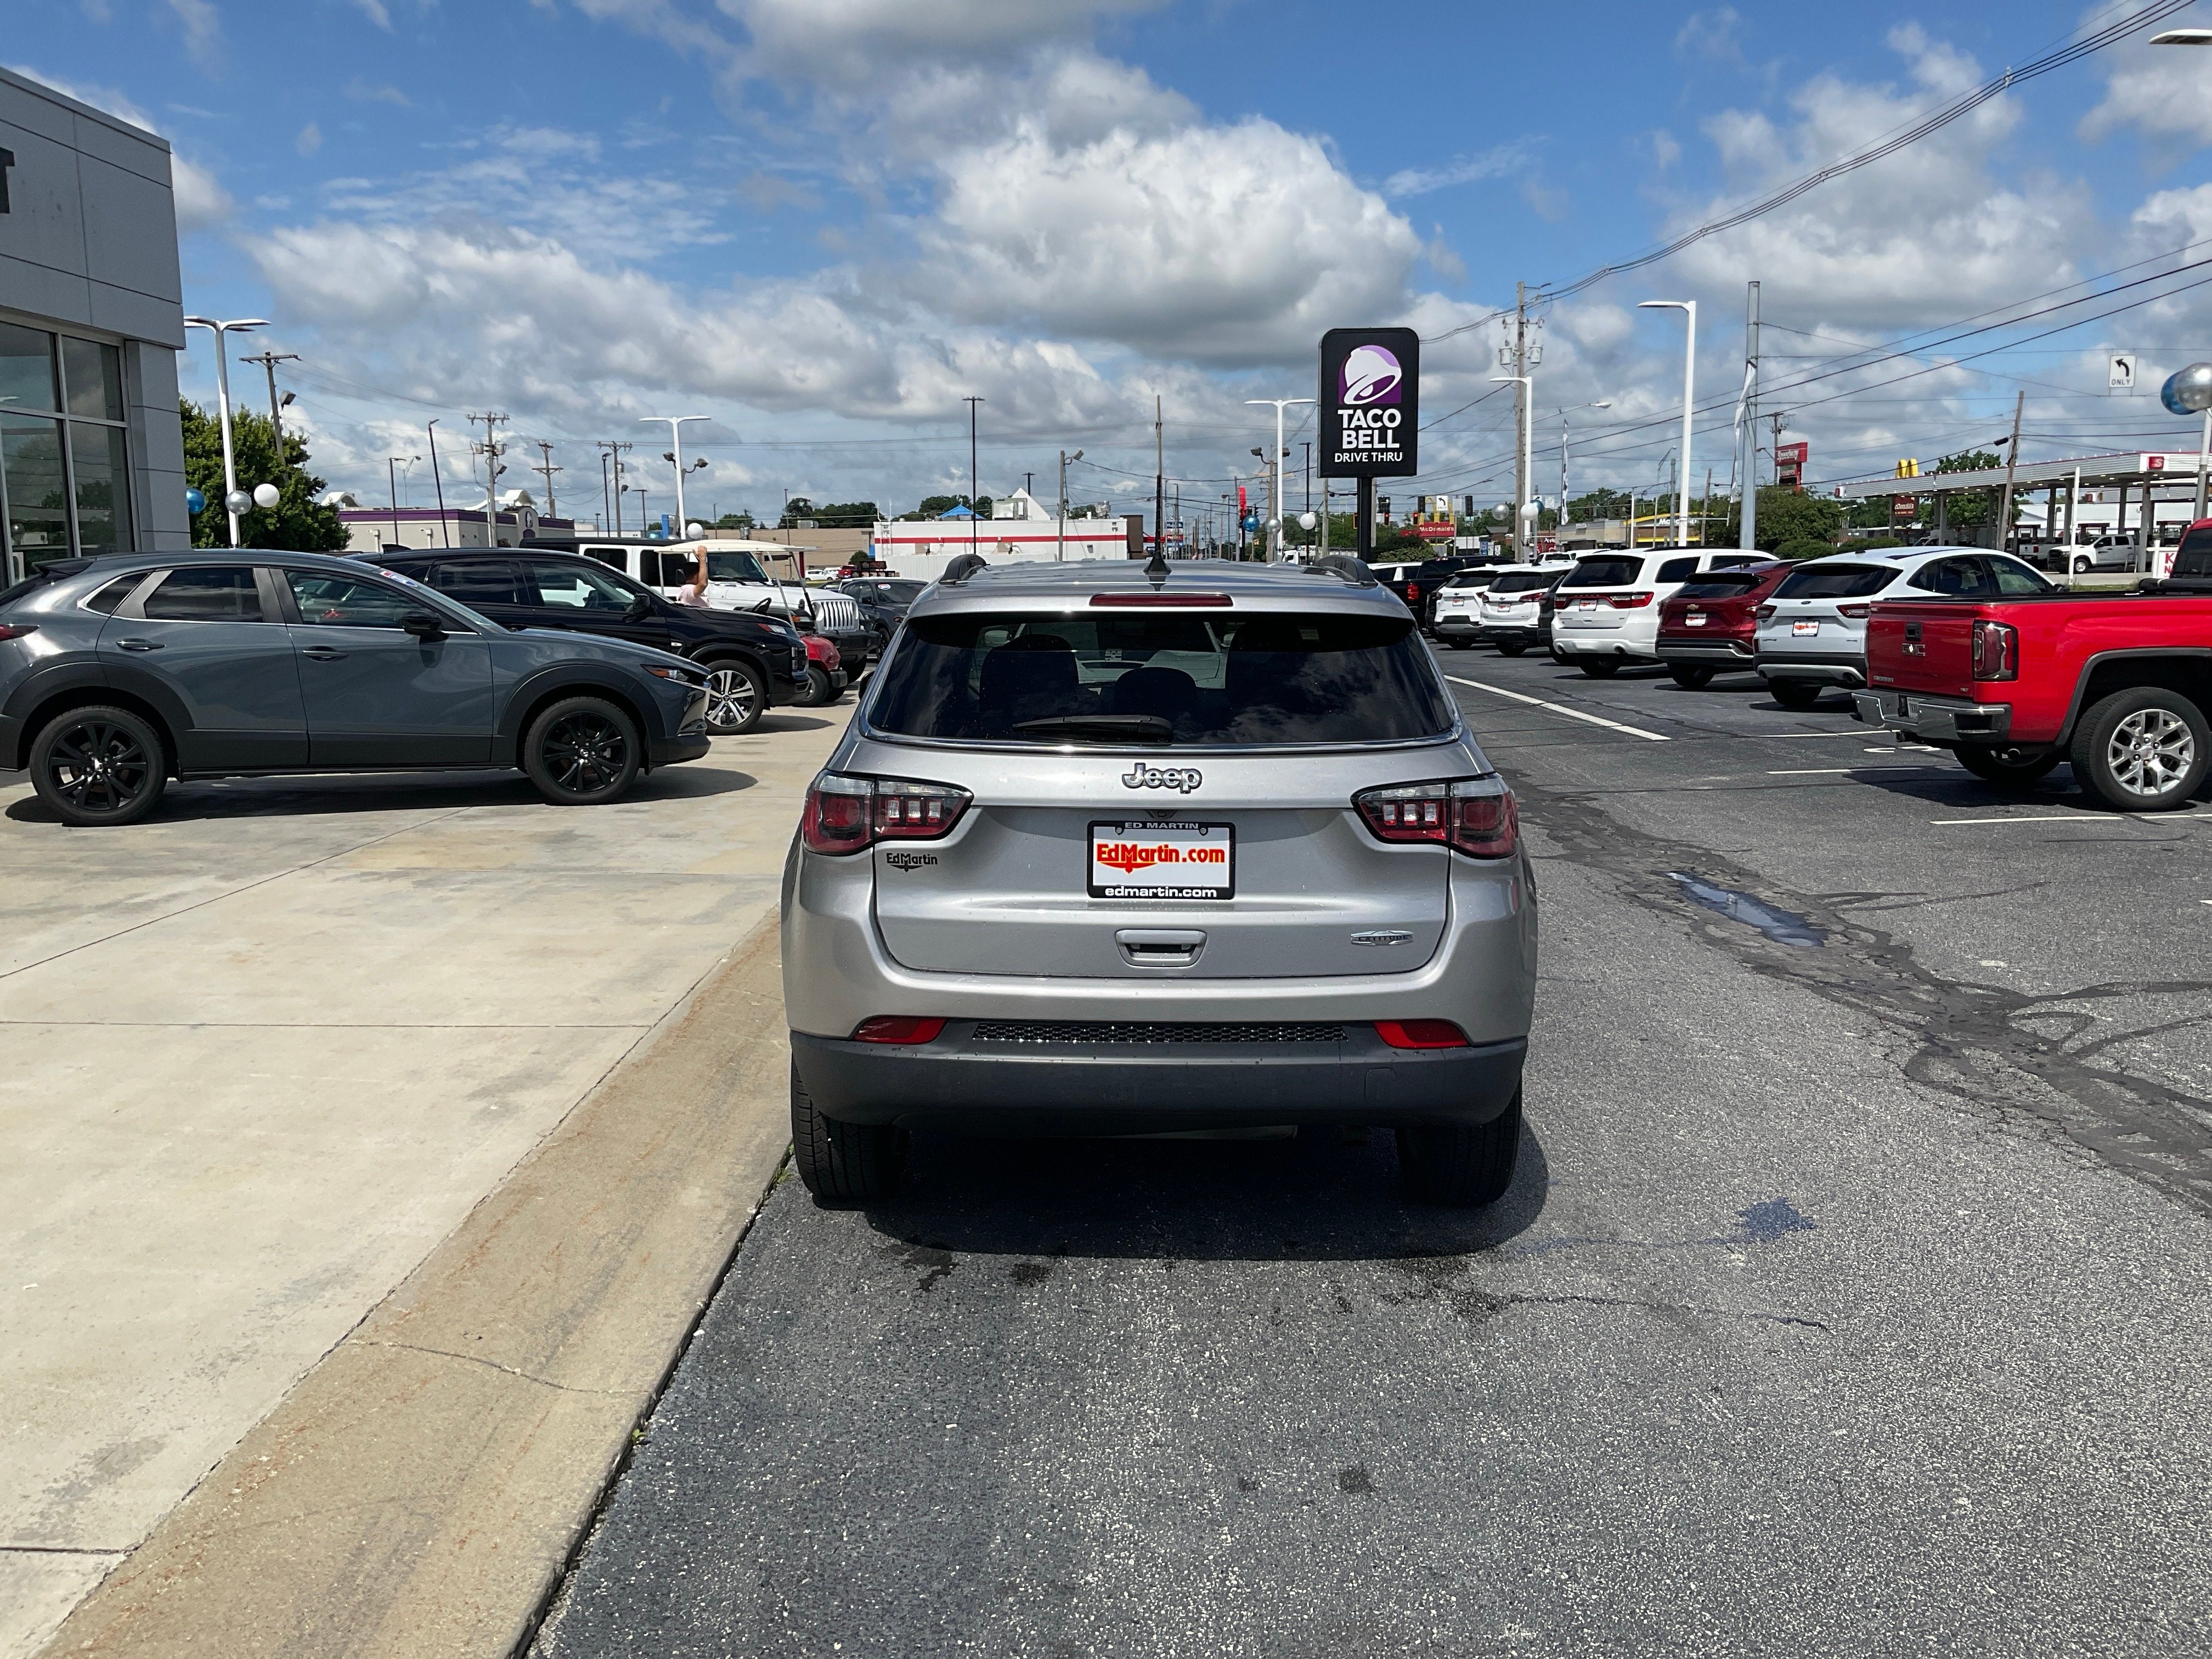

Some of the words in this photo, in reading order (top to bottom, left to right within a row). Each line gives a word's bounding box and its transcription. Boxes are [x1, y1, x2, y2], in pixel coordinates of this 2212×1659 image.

[1337, 408, 1401, 428] TACO
[1342, 430, 1400, 449] BELL
[1334, 452, 1368, 462] DRIVE
[1370, 452, 1403, 462] THRU
[1122, 763, 1203, 794] Jeep
[886, 853, 938, 867] EdMartin
[1096, 843, 1226, 867] EdMartin.com
[1105, 886, 1217, 898] edmartin.com
